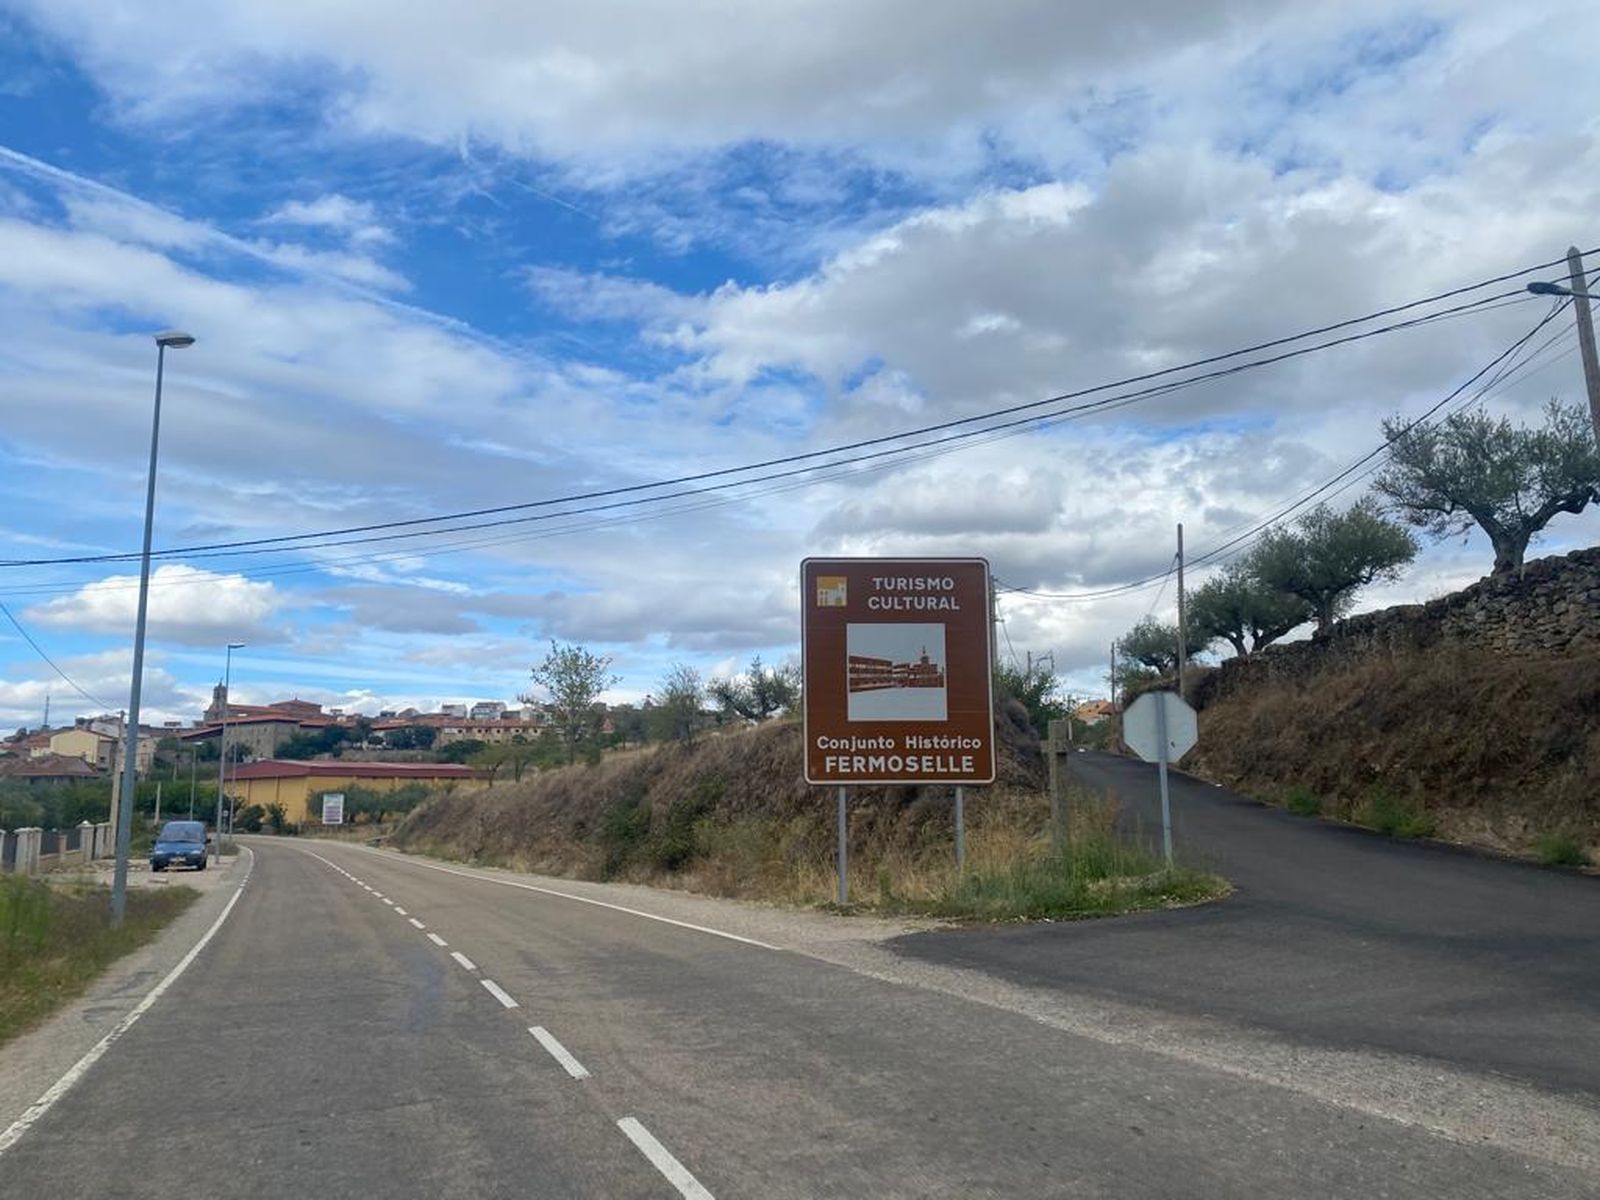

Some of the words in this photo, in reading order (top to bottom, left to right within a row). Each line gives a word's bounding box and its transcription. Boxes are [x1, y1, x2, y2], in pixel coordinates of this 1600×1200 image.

[872, 577, 955, 591] TURISMO
[868, 596, 961, 610] CULTURAL
[816, 736, 895, 752] Conjunto
[905, 735, 982, 750] Histórico
[825, 755, 975, 773] FERMOSELLE
